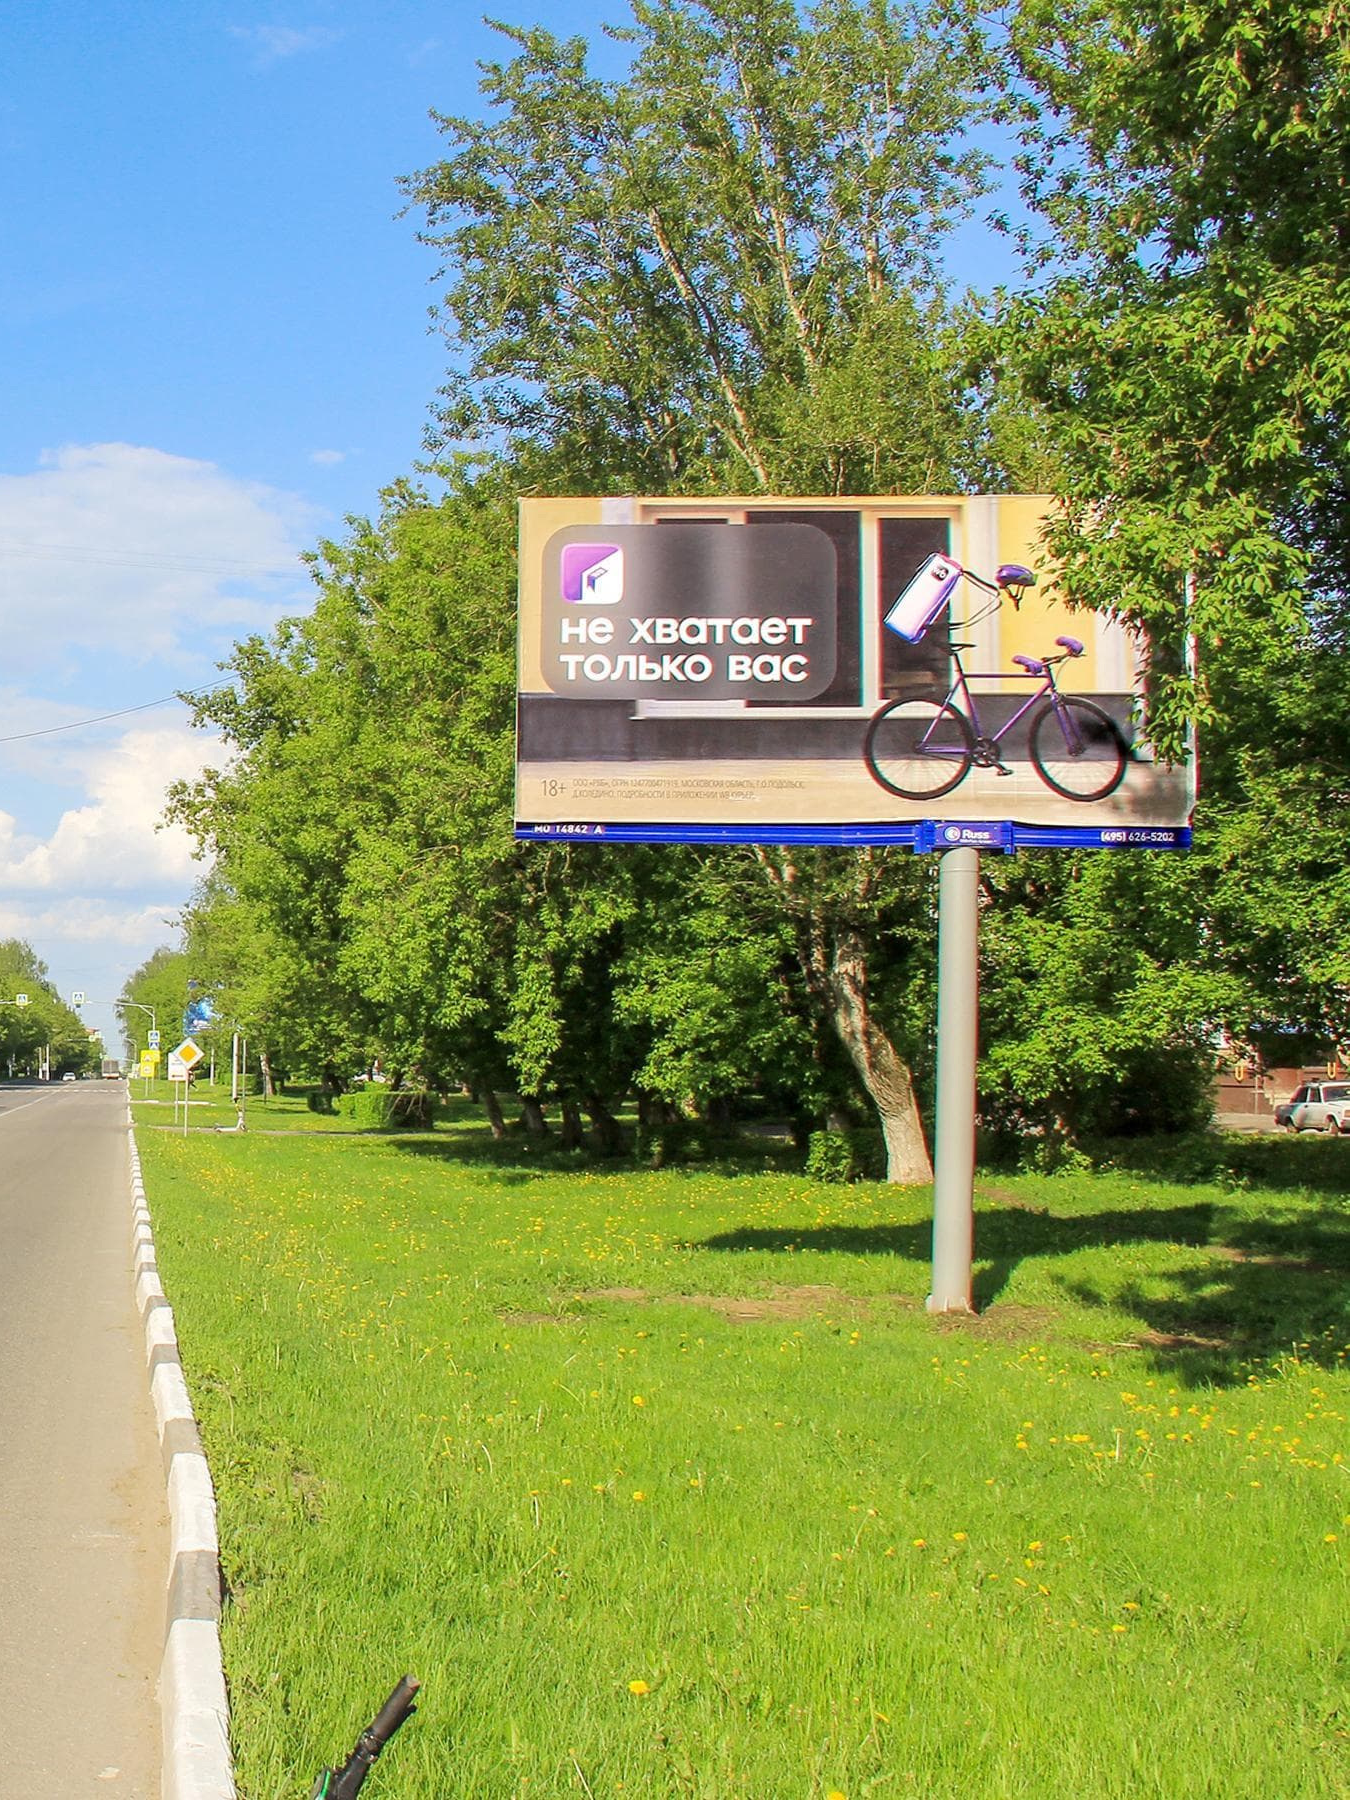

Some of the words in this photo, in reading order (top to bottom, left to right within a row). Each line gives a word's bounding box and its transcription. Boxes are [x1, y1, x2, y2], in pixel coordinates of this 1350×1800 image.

[561, 617, 614, 645] не
[628, 616, 812, 645] хватает
[559, 654, 713, 682] только
[728, 654, 809, 682] вас
[540, 779, 567, 797] 18+
[962, 829, 989, 839] Russ
[1101, 831, 1126, 842] (495)
[1128, 832, 1174, 842] 626-5202
